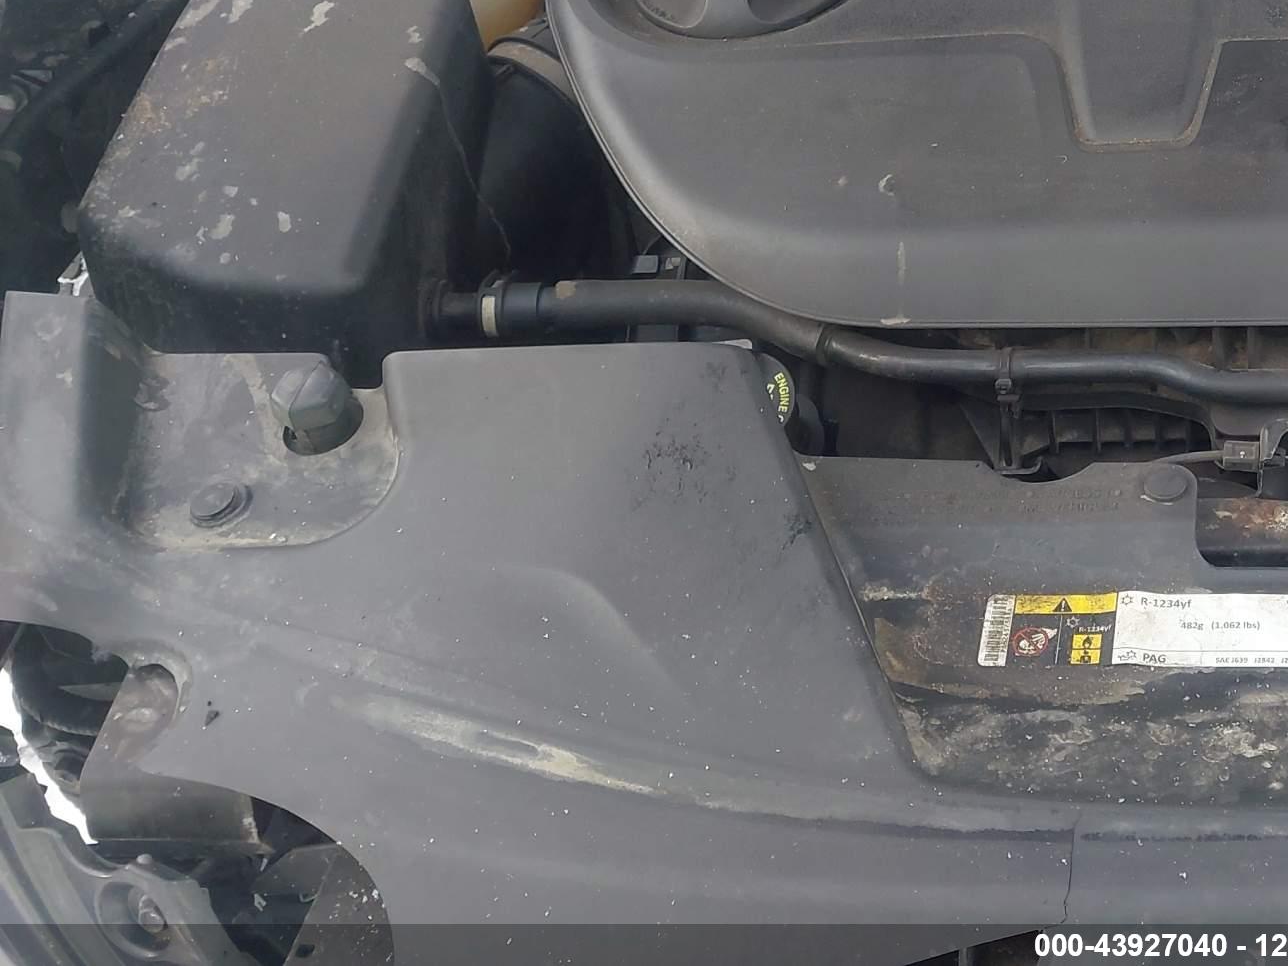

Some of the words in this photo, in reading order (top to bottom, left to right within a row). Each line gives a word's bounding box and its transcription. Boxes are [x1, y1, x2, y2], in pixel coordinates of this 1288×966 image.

[774, 372, 790, 413] ENGINE
[1141, 597, 1192, 610] R-1234yf
[1180, 621, 1204, 630] 482g
[1211, 621, 1241, 631] (1.062
[1243, 621, 1261, 631] lbs)
[1142, 652, 1167, 664] PAG
